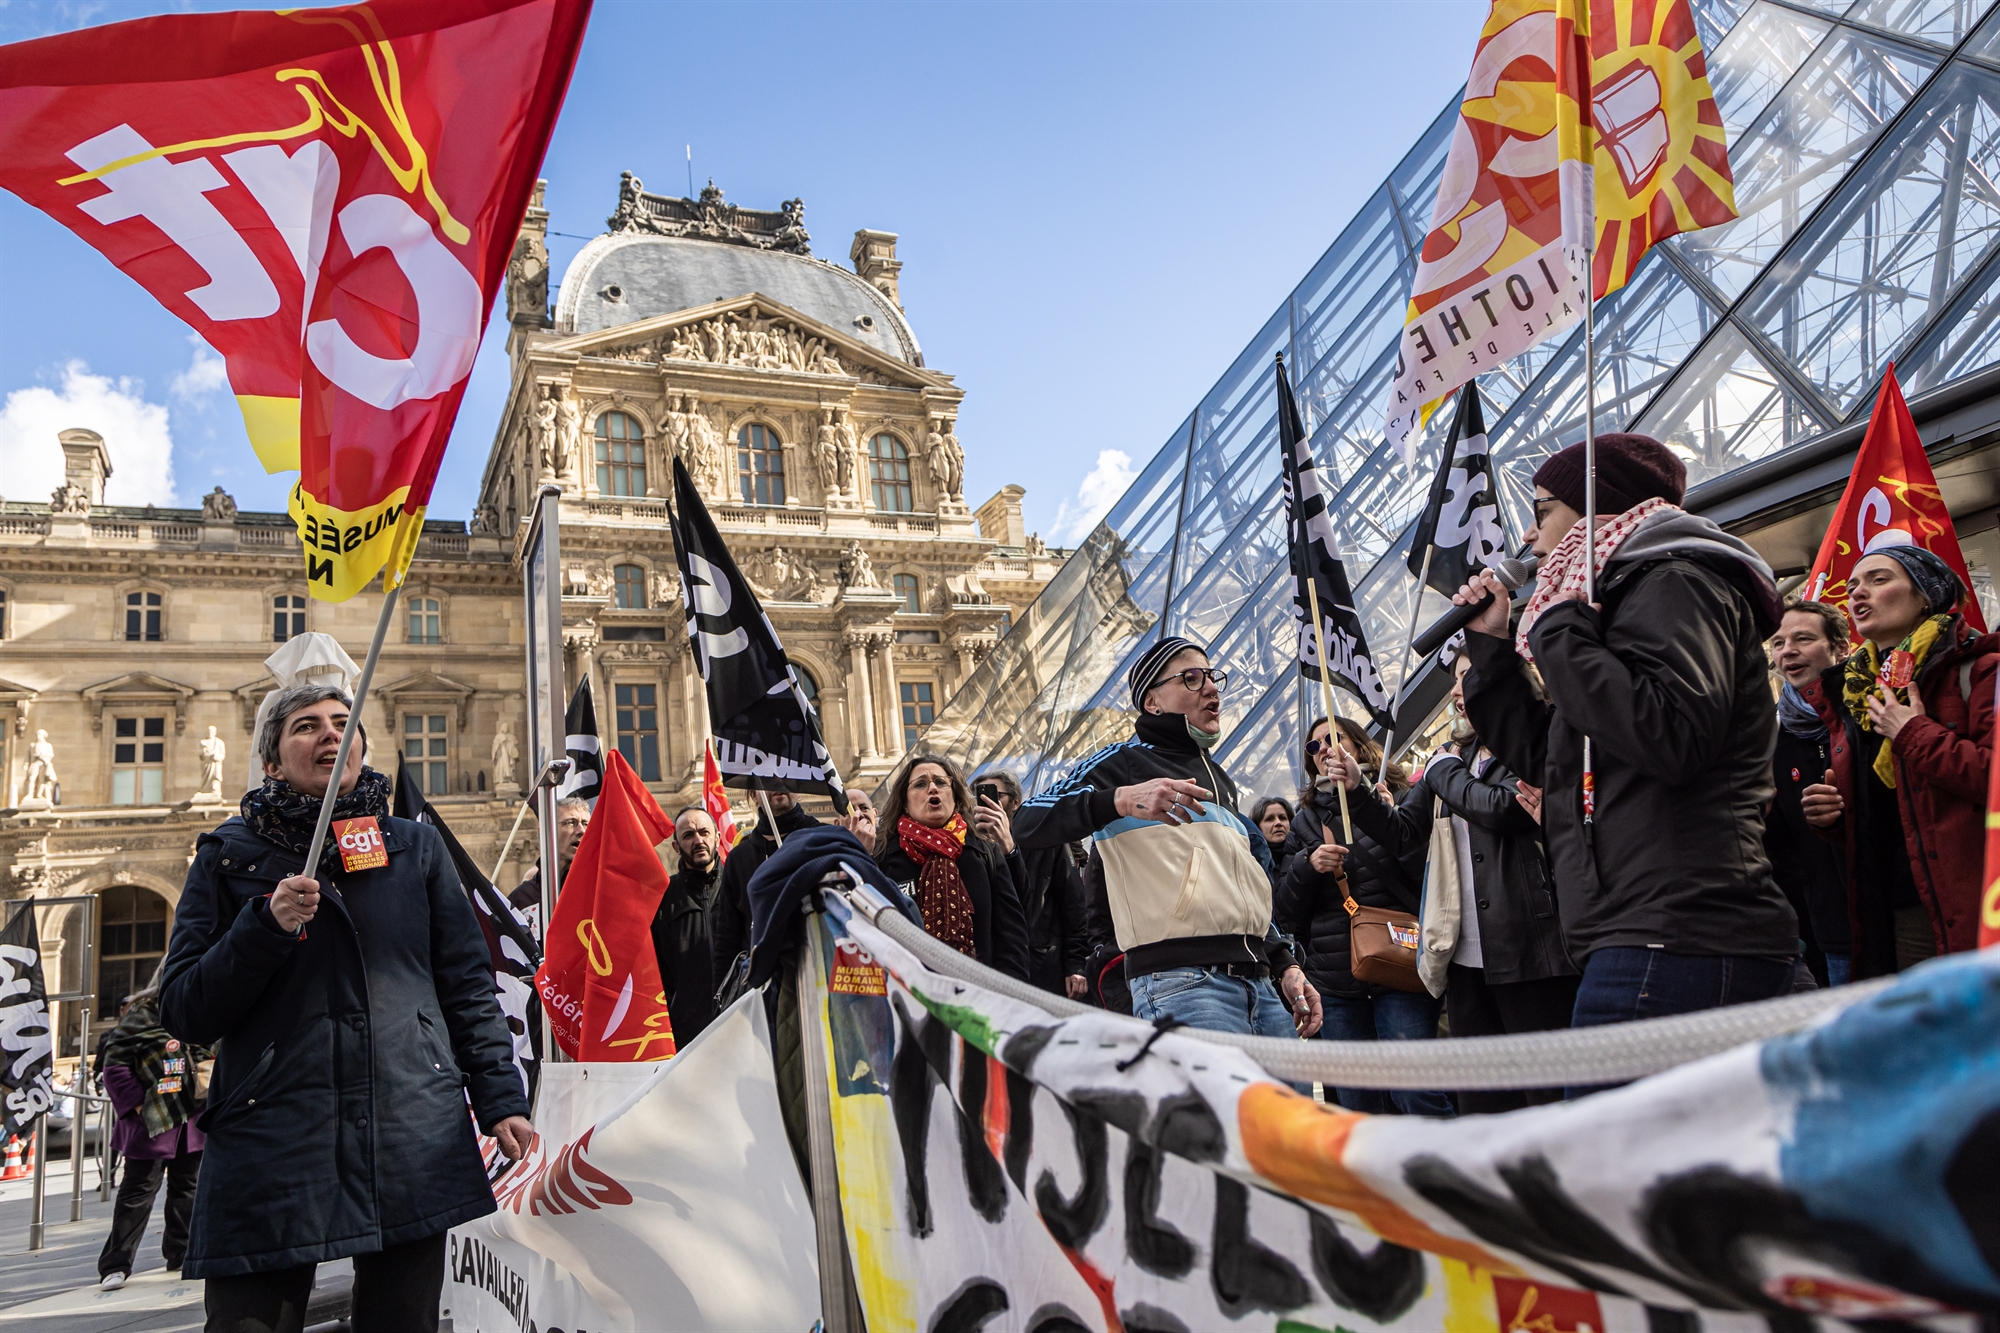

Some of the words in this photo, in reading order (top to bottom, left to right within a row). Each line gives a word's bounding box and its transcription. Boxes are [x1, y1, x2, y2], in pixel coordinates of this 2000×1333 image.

[341, 826, 381, 853] cgt
[347, 855, 386, 866] DOMAINES
[348, 860, 386, 871] NATIONAUX
[539, 975, 583, 1029] édér
